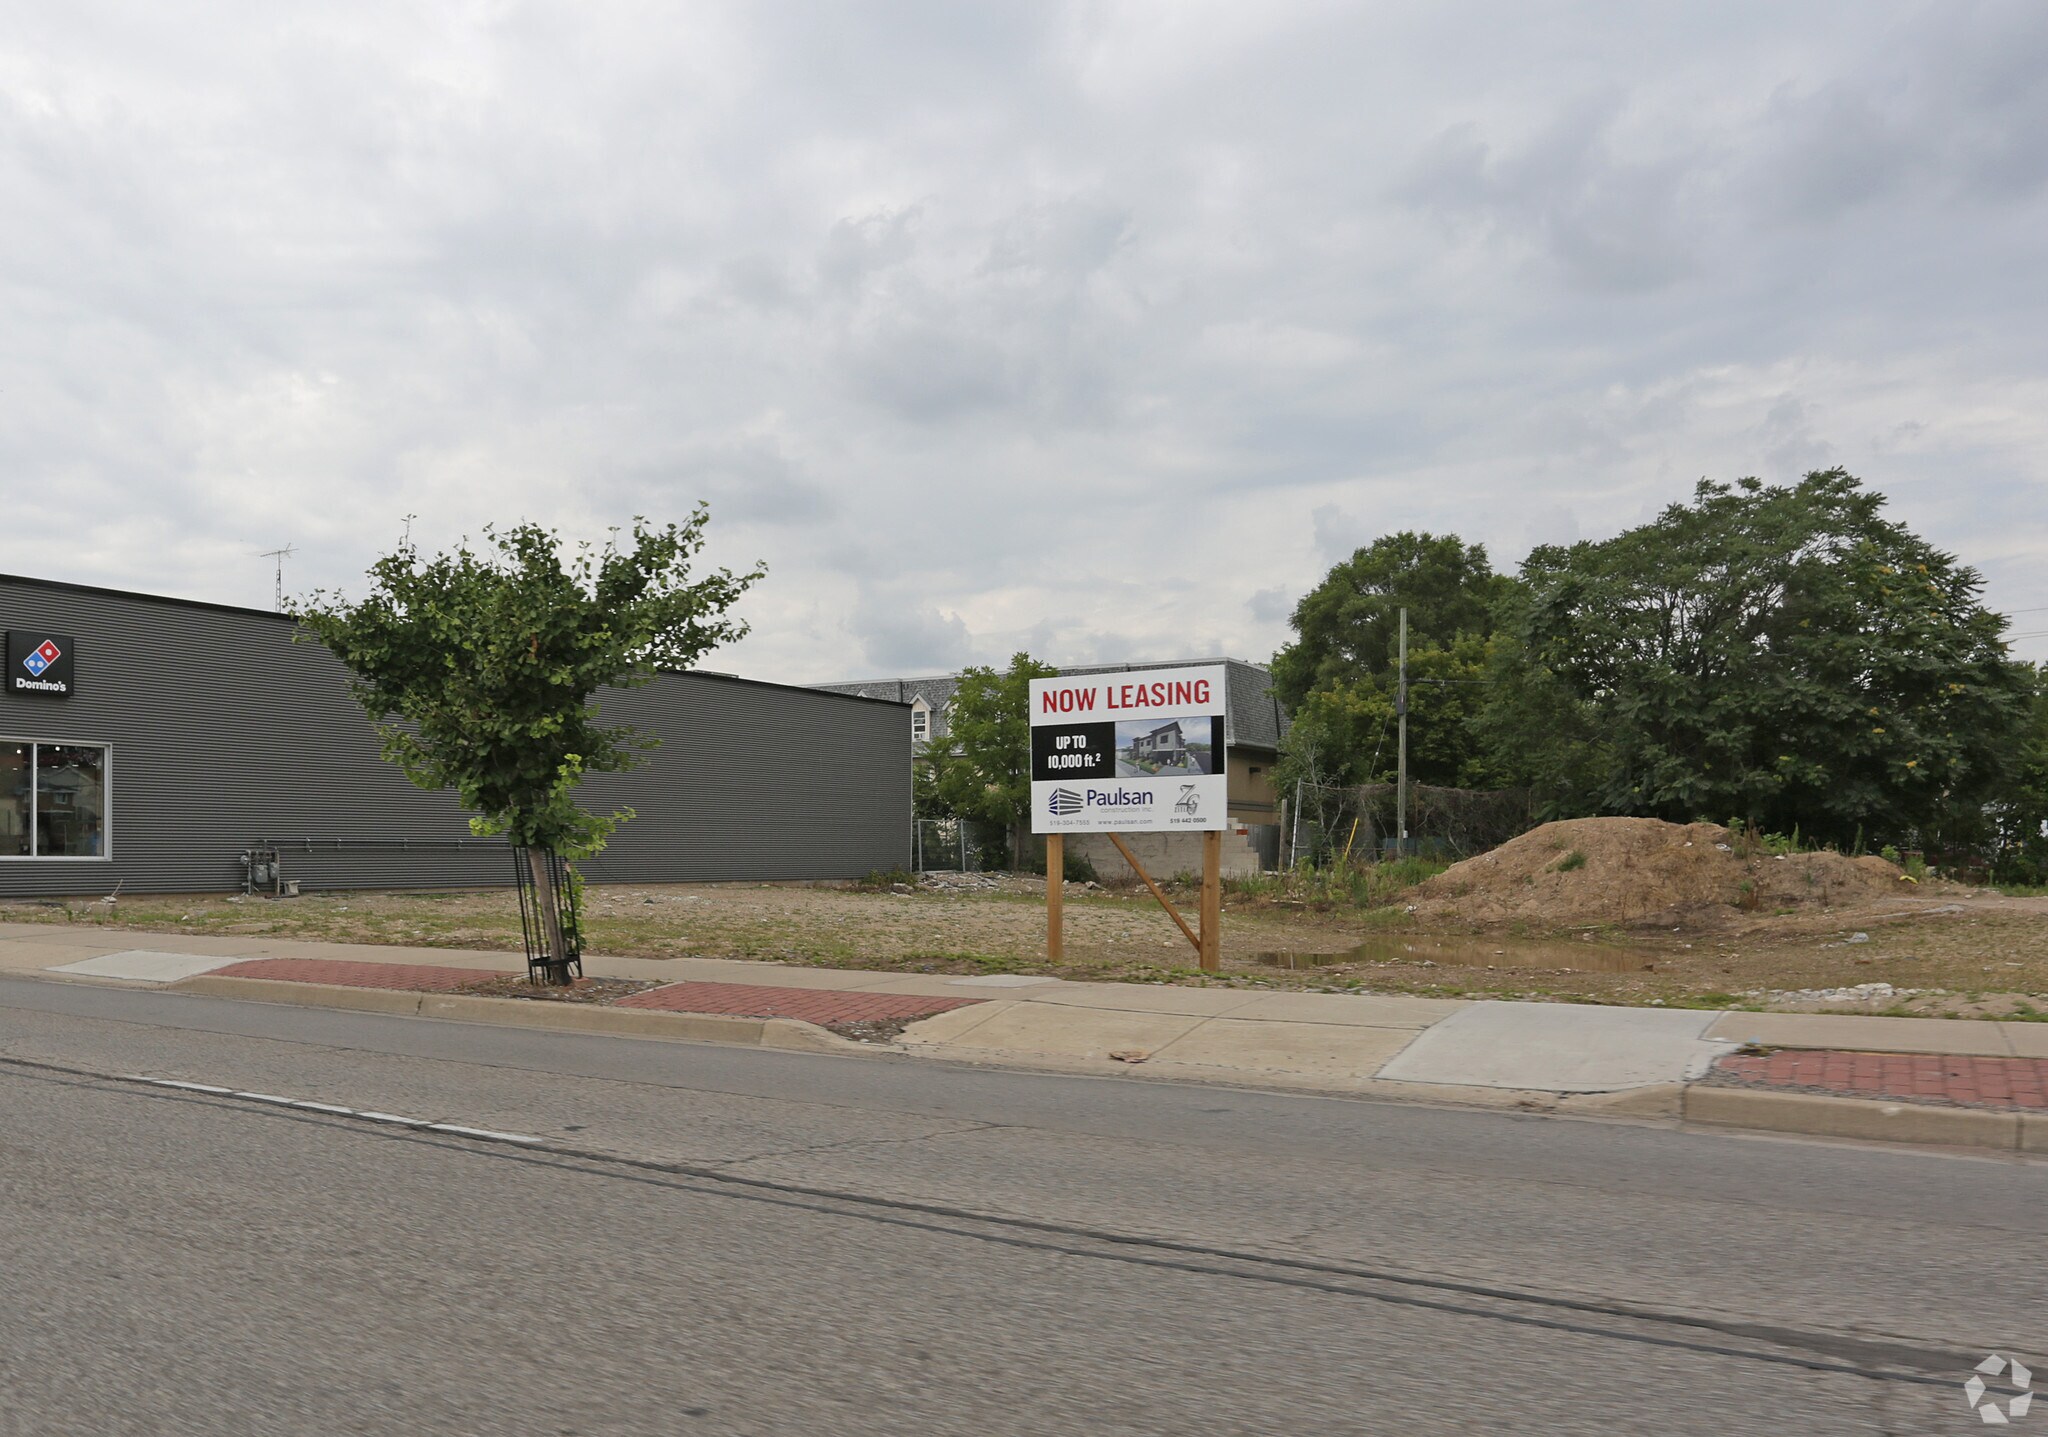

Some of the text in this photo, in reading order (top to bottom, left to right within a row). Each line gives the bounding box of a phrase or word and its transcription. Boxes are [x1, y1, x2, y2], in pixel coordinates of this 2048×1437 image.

[16, 678, 66, 692] Domino's
[1043, 679, 1210, 713] NOW LEASING
[1056, 735, 1087, 750] UP TO
[1048, 754, 1083, 770] 10,000
[1087, 787, 1153, 806] Paulsan
